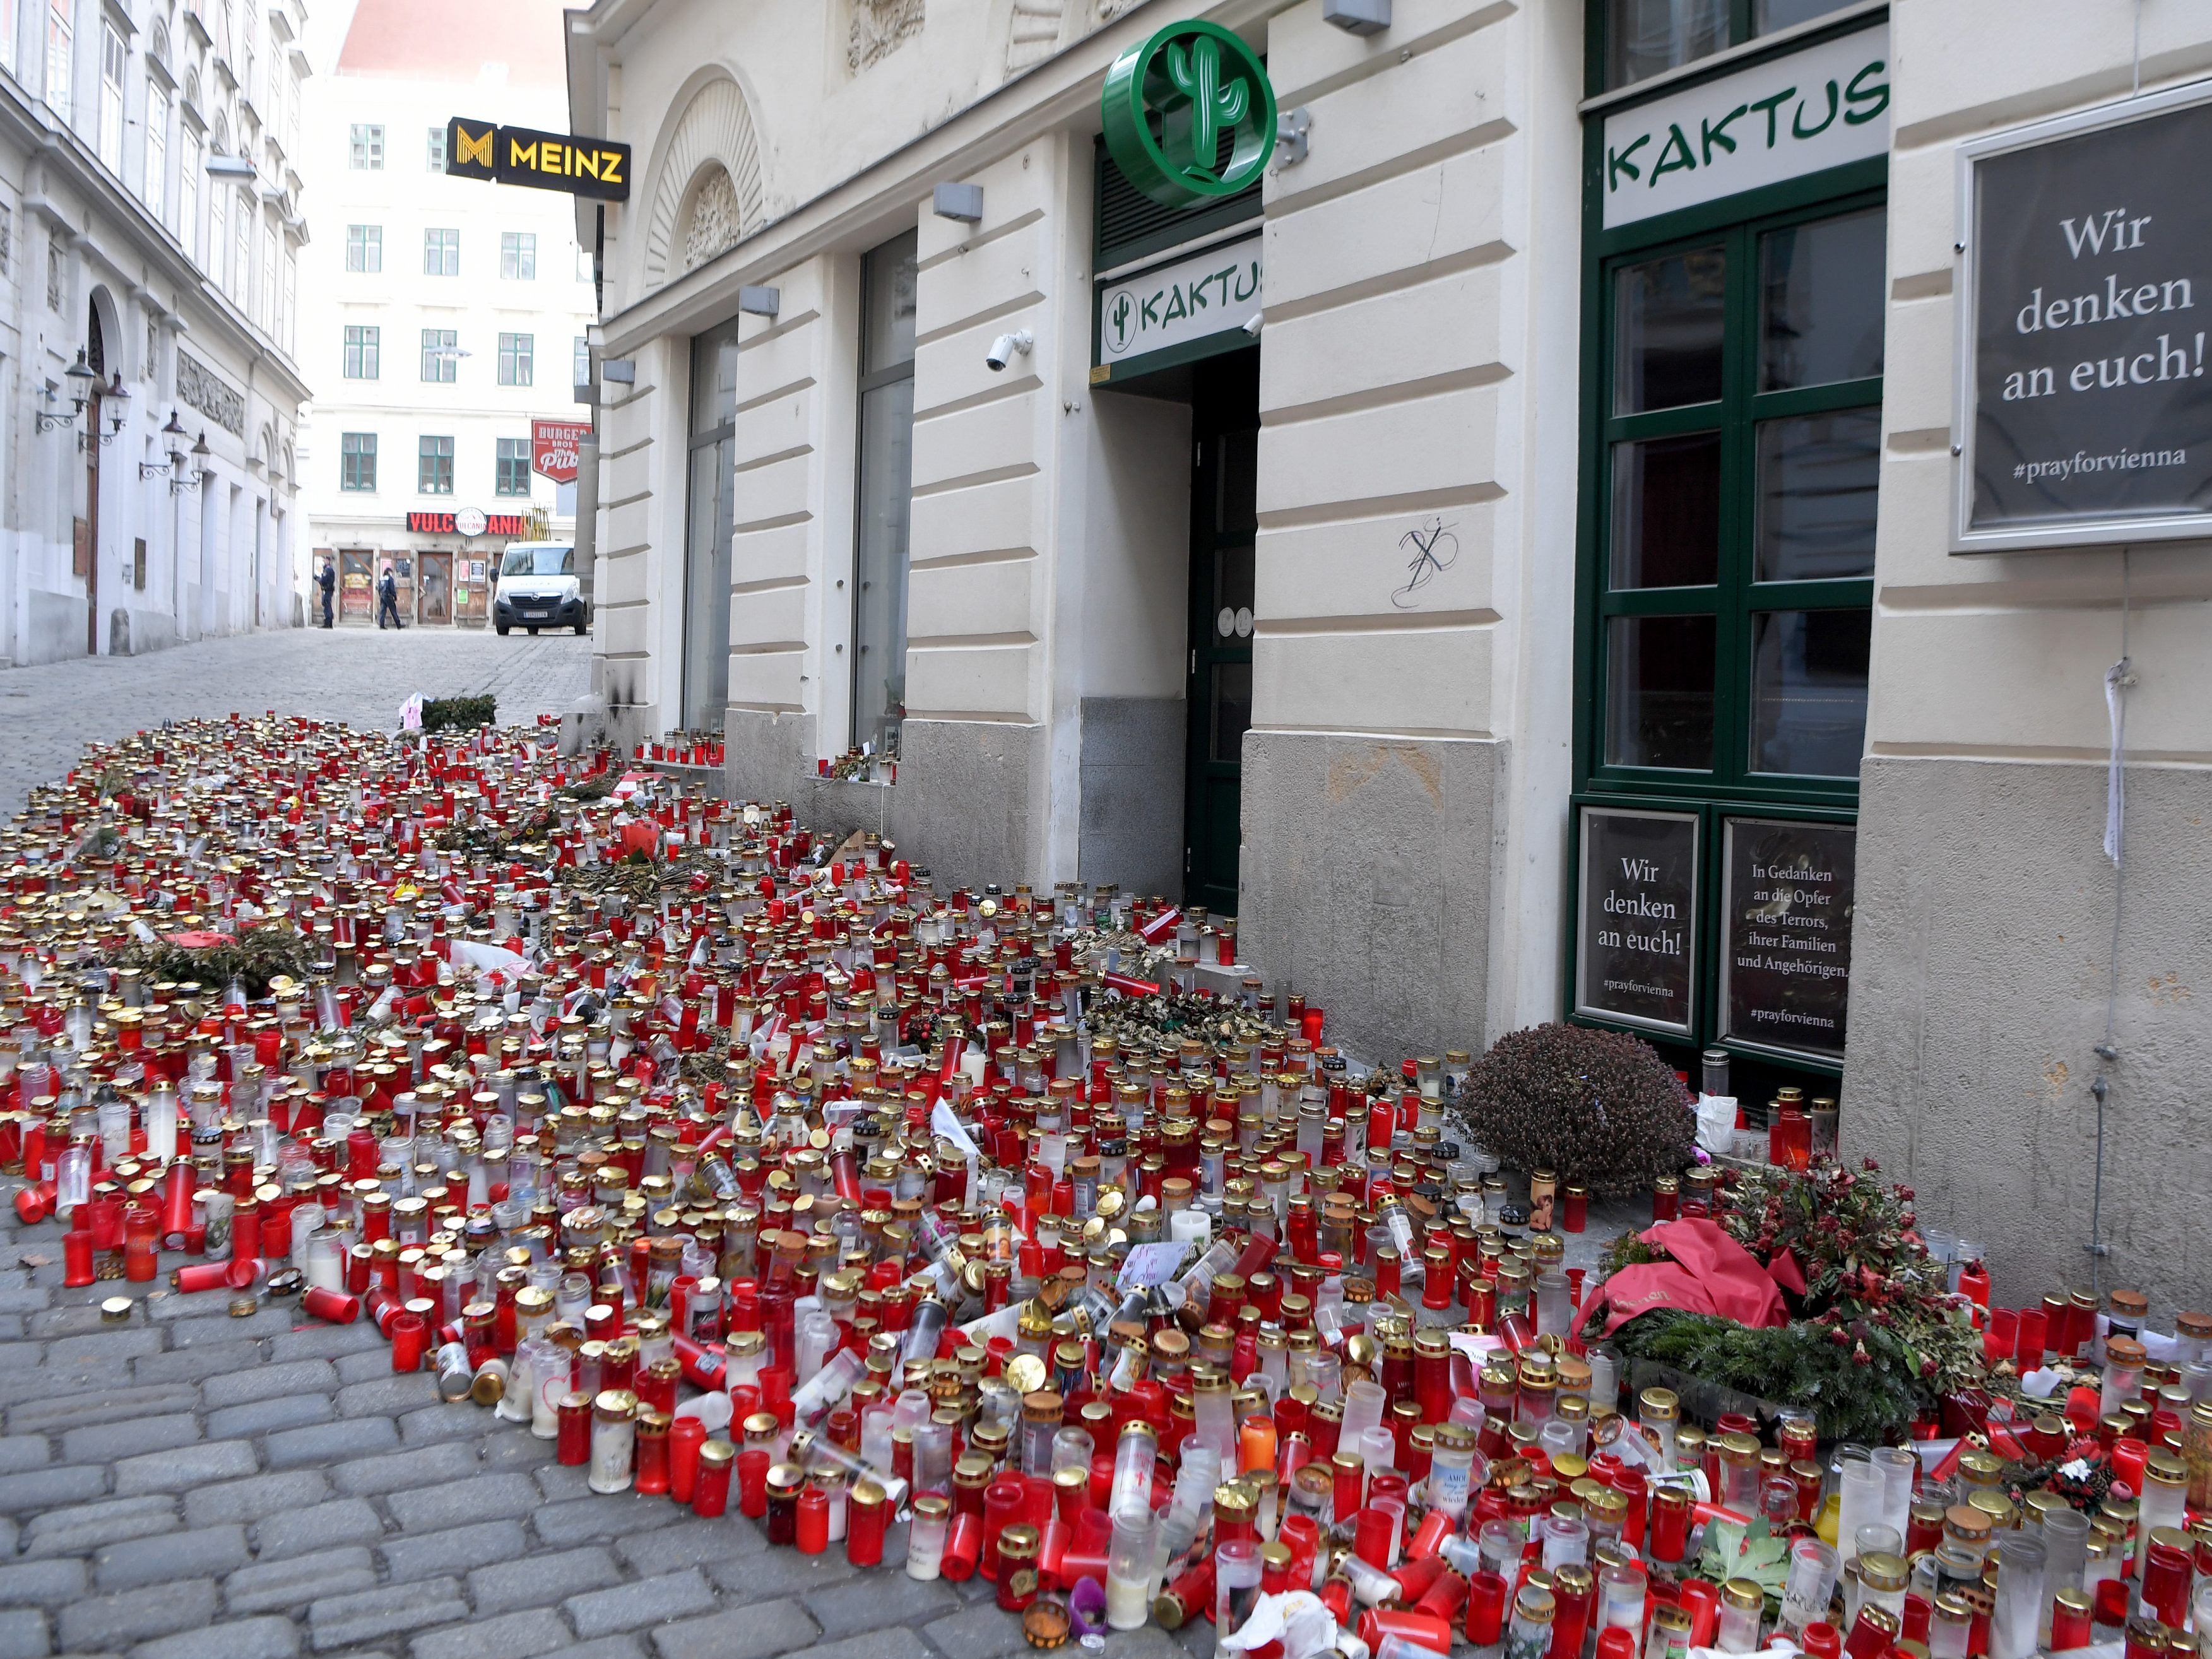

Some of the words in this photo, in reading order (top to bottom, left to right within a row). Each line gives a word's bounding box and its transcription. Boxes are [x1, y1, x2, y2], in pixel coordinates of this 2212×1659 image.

[1608, 60, 1890, 192] KAKTUS
[510, 136, 624, 184] MEINZ
[2059, 208, 2152, 260] Wir
[1141, 261, 1262, 332] KAKTU
[2016, 274, 2194, 335] denken
[2002, 366, 2056, 401] an
[2069, 332, 2206, 393] euch!
[552, 440, 573, 448] BROS
[554, 448, 572, 457] The
[540, 451, 579, 472] Pub
[2012, 447, 2187, 485] #prayforvienna
[1621, 857, 1659, 883] Wir
[1752, 865, 1766, 878] In
[1768, 865, 1832, 882] Gedanken
[1603, 890, 1676, 919] denken
[1753, 890, 1768, 901] an
[1771, 887, 1792, 902] die
[1794, 889, 1831, 907] Opfer
[1756, 910, 1777, 924] des
[1778, 912, 1829, 931] Terrors,
[1598, 930, 1621, 948] an
[1626, 930, 1681, 955] euch!
[1748, 931, 1778, 948] ihrer
[1781, 935, 1836, 953] Familien
[1737, 955, 1761, 969] und
[1763, 957, 1848, 979] Angehörigen.
[1604, 978, 1674, 998] #prayforvienna
[1751, 1008, 1835, 1029] #prayforvienna
